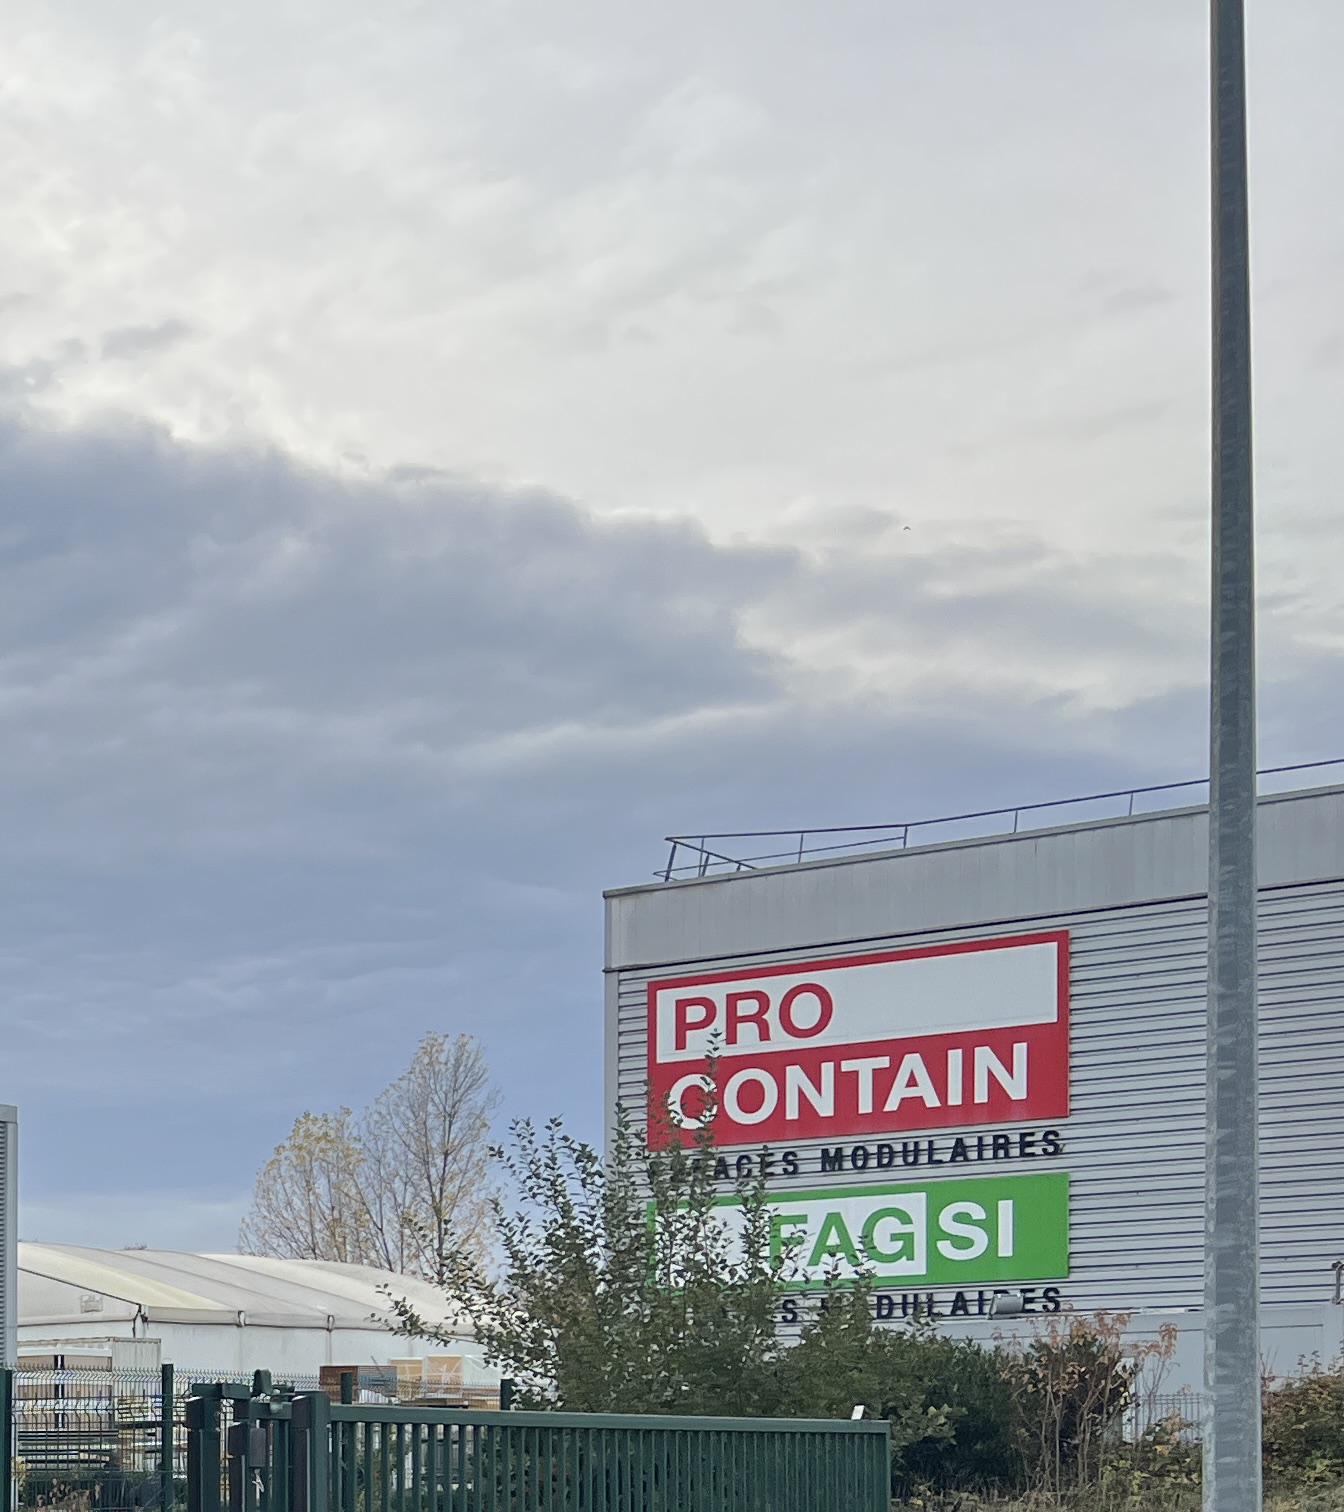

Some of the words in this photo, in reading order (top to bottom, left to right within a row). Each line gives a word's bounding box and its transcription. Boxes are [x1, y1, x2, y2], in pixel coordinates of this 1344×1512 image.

[673, 982, 834, 1051] PRO
[666, 1042, 1029, 1130] CONTAIN
[820, 1130, 1062, 1174] MODULAIRES
[768, 1199, 1014, 1271] FAGSI
[820, 1287, 1060, 1323] DULAIES
